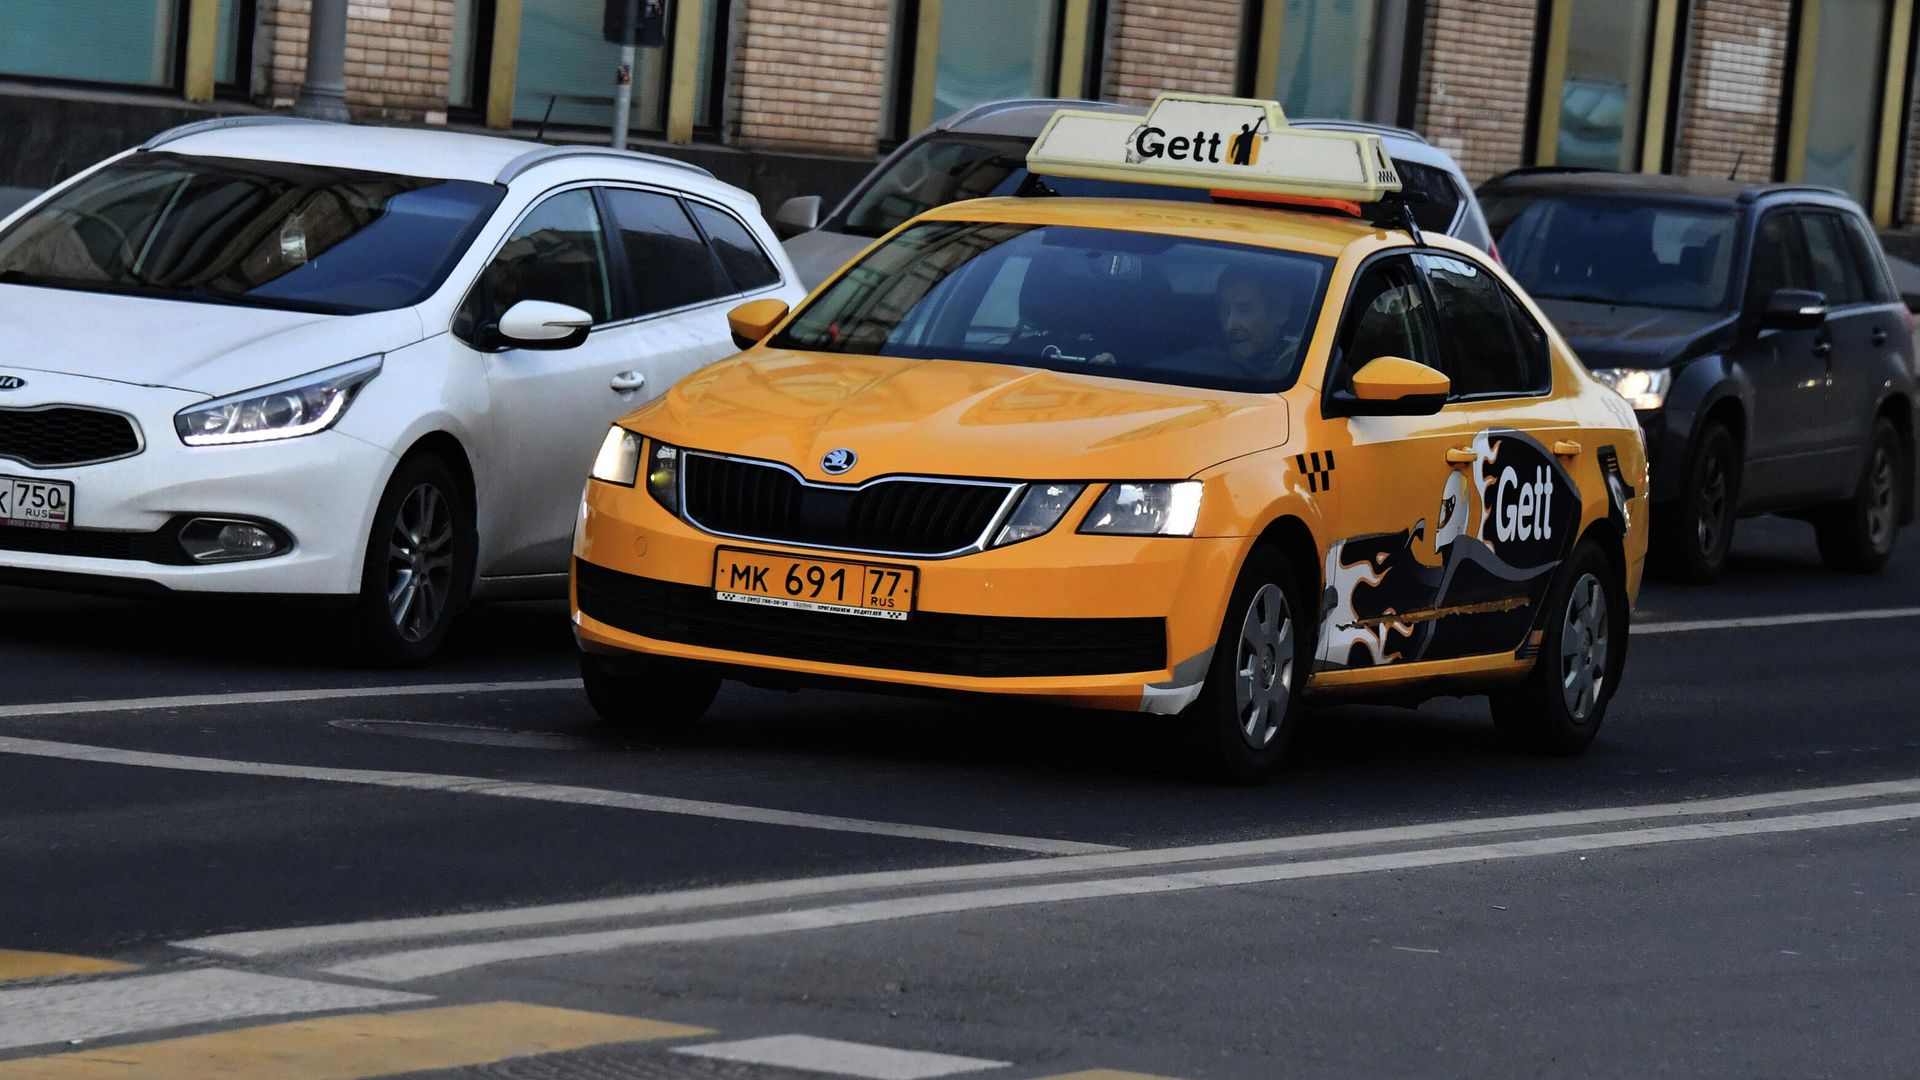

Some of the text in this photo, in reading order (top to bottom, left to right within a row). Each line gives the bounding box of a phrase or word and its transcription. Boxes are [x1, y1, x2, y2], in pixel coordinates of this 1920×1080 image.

[1136, 126, 1222, 164] Gett
[0, 376, 18, 388] IA
[17, 484, 61, 509] 750
[1495, 464, 1554, 543] Gett
[25, 508, 48, 518] RUS
[785, 563, 846, 601] 691
[869, 570, 901, 597] 77
[870, 597, 895, 608] RUS
